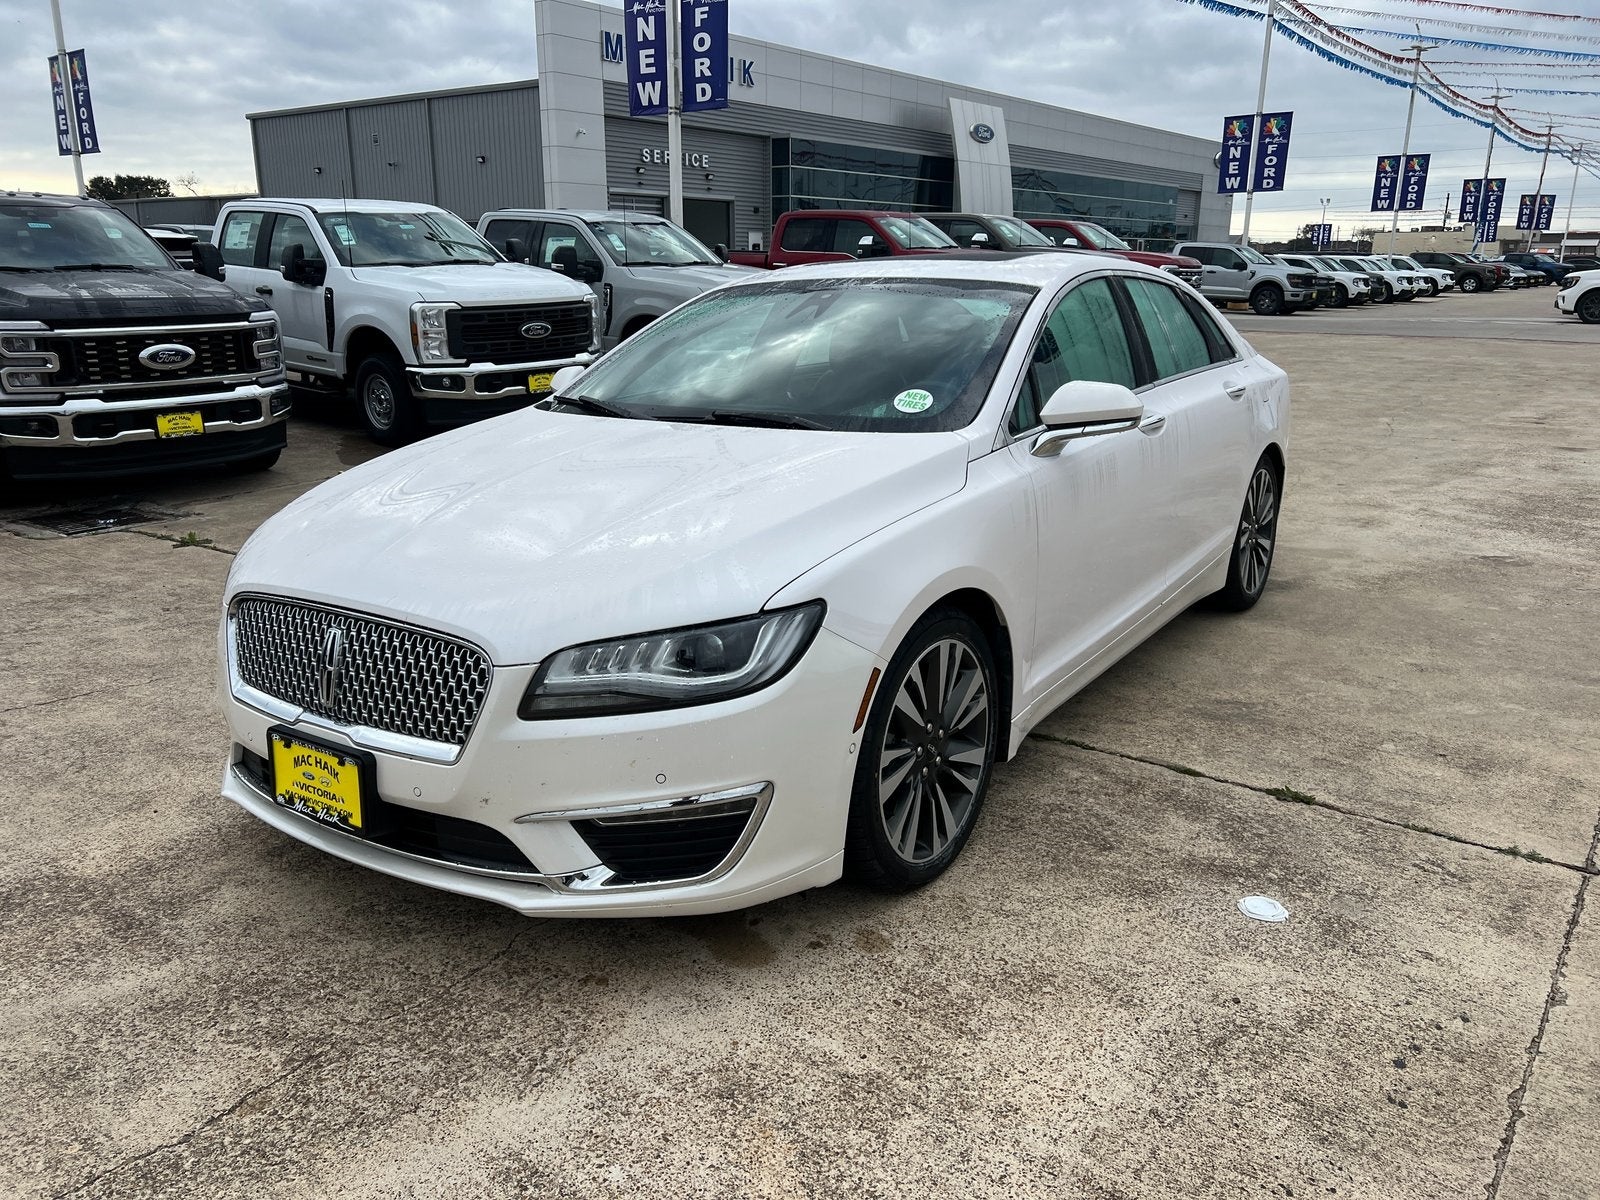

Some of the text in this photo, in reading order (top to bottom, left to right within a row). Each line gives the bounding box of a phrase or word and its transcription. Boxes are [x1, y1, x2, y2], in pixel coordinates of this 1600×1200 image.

[636, 16, 661, 106] NEW
[692, 6, 713, 102] FORD
[56, 95, 71, 150] NEW
[78, 92, 93, 149] FORD
[642, 148, 709, 167] SERICE
[1225, 146, 1241, 189] NEW
[1262, 144, 1278, 188] FORD
[1377, 178, 1390, 208] NEW
[1406, 177, 1419, 208] FORD
[1463, 196, 1474, 220] NEW
[1486, 196, 1498, 220] FORD
[1520, 209, 1529, 228] NEW
[1539, 209, 1548, 228] FORD
[157, 351, 182, 363] Ford
[896, 398, 927, 410] TIRES
[904, 391, 930, 401] NEW
[293, 754, 340, 784] MAC HAIK
